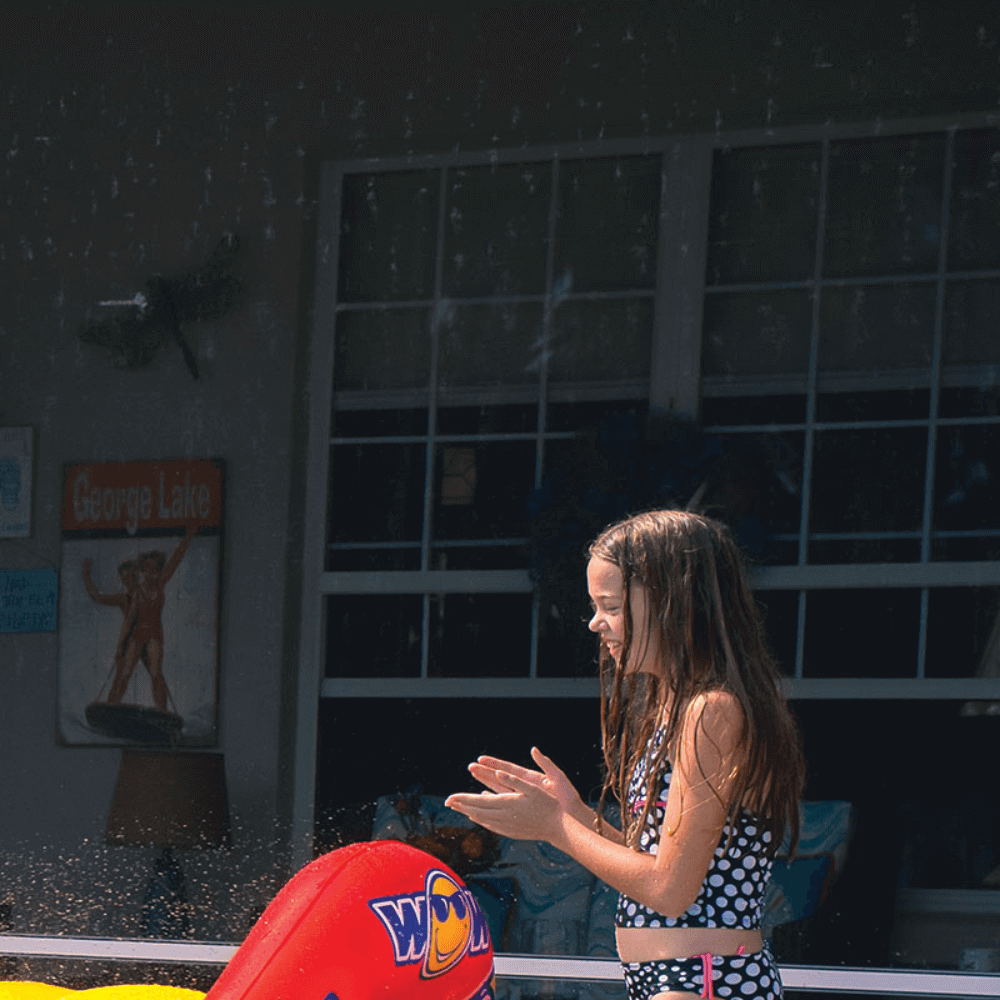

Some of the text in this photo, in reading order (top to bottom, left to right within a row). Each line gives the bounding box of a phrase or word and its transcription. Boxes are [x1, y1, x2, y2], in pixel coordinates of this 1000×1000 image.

[72, 469, 211, 535] George Lake
[367, 868, 490, 980] WOW
